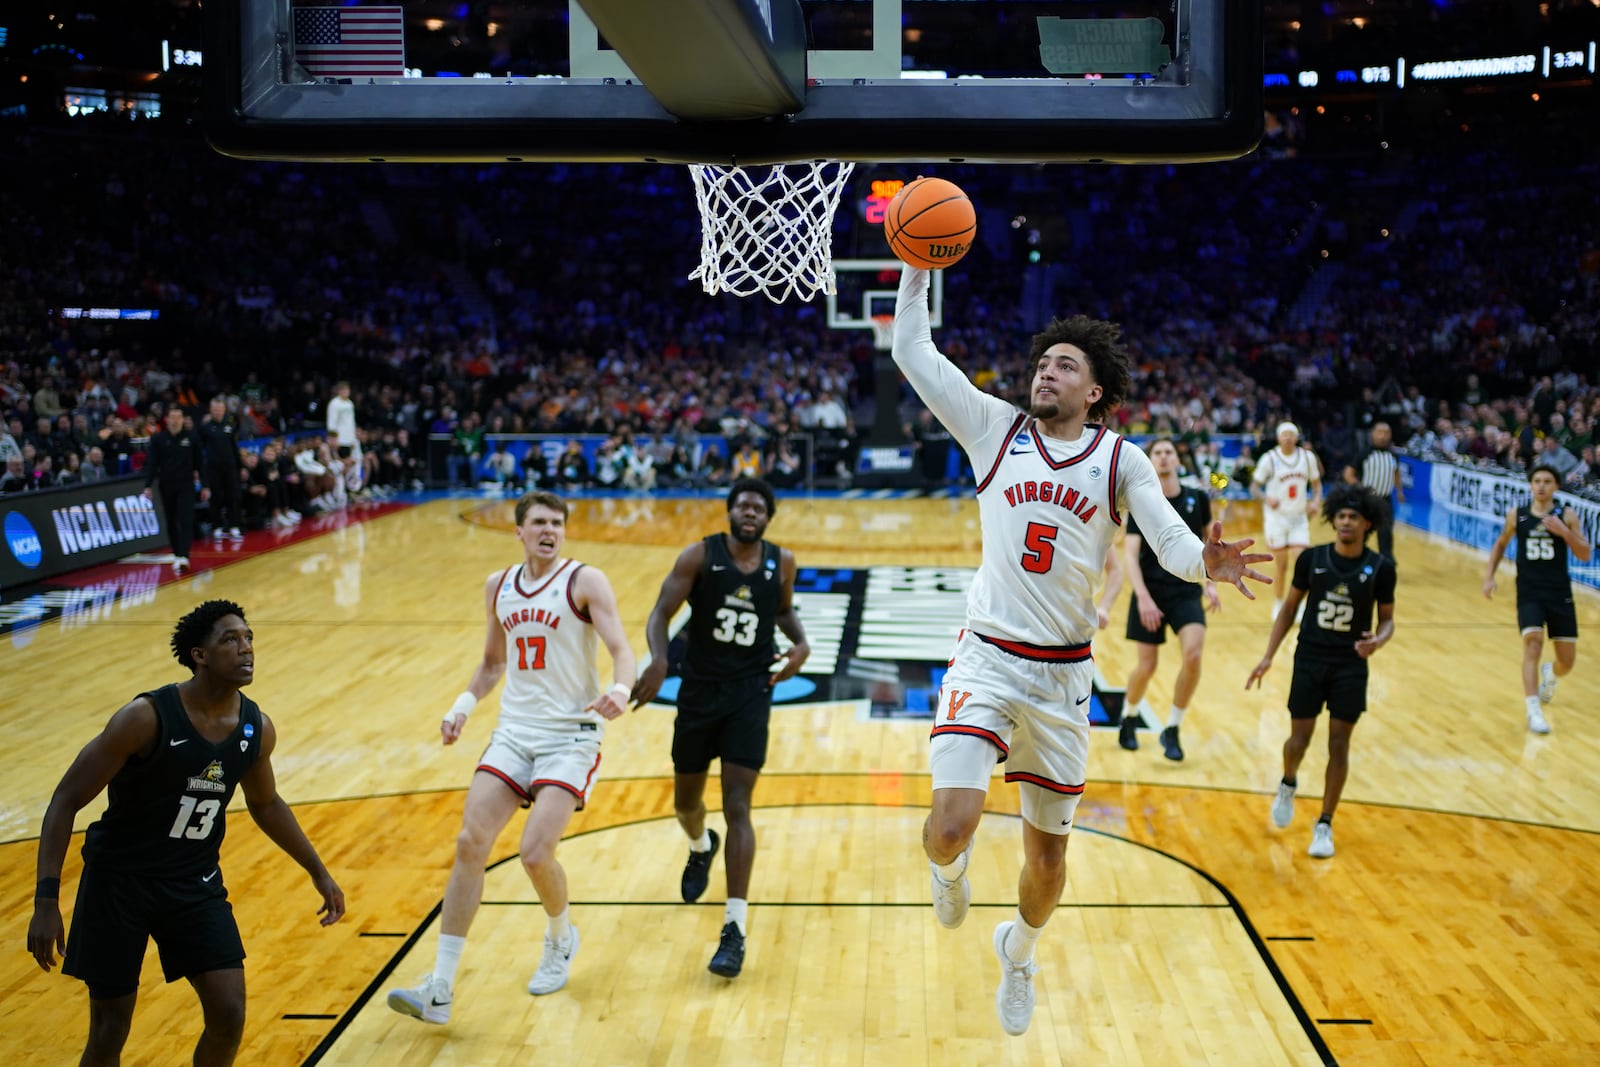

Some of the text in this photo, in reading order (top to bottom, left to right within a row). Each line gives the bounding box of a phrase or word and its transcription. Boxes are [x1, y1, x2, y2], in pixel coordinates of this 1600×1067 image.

[1411, 54, 1537, 80] #MARCHMADNESS
[1553, 50, 1584, 68] 3:34
[1004, 481, 1098, 524] VIRGINIA
[1450, 472, 1482, 512] FIRST
[52, 495, 160, 556] NCAA.ORG
[12, 536, 42, 556] NCAA
[1021, 521, 1059, 574] 5
[1526, 538, 1555, 561] 55
[502, 608, 561, 632] VIRGINIA
[712, 607, 760, 647] 33
[1317, 600, 1354, 632] 22
[515, 636, 547, 670] 17
[168, 795, 221, 840] 13
